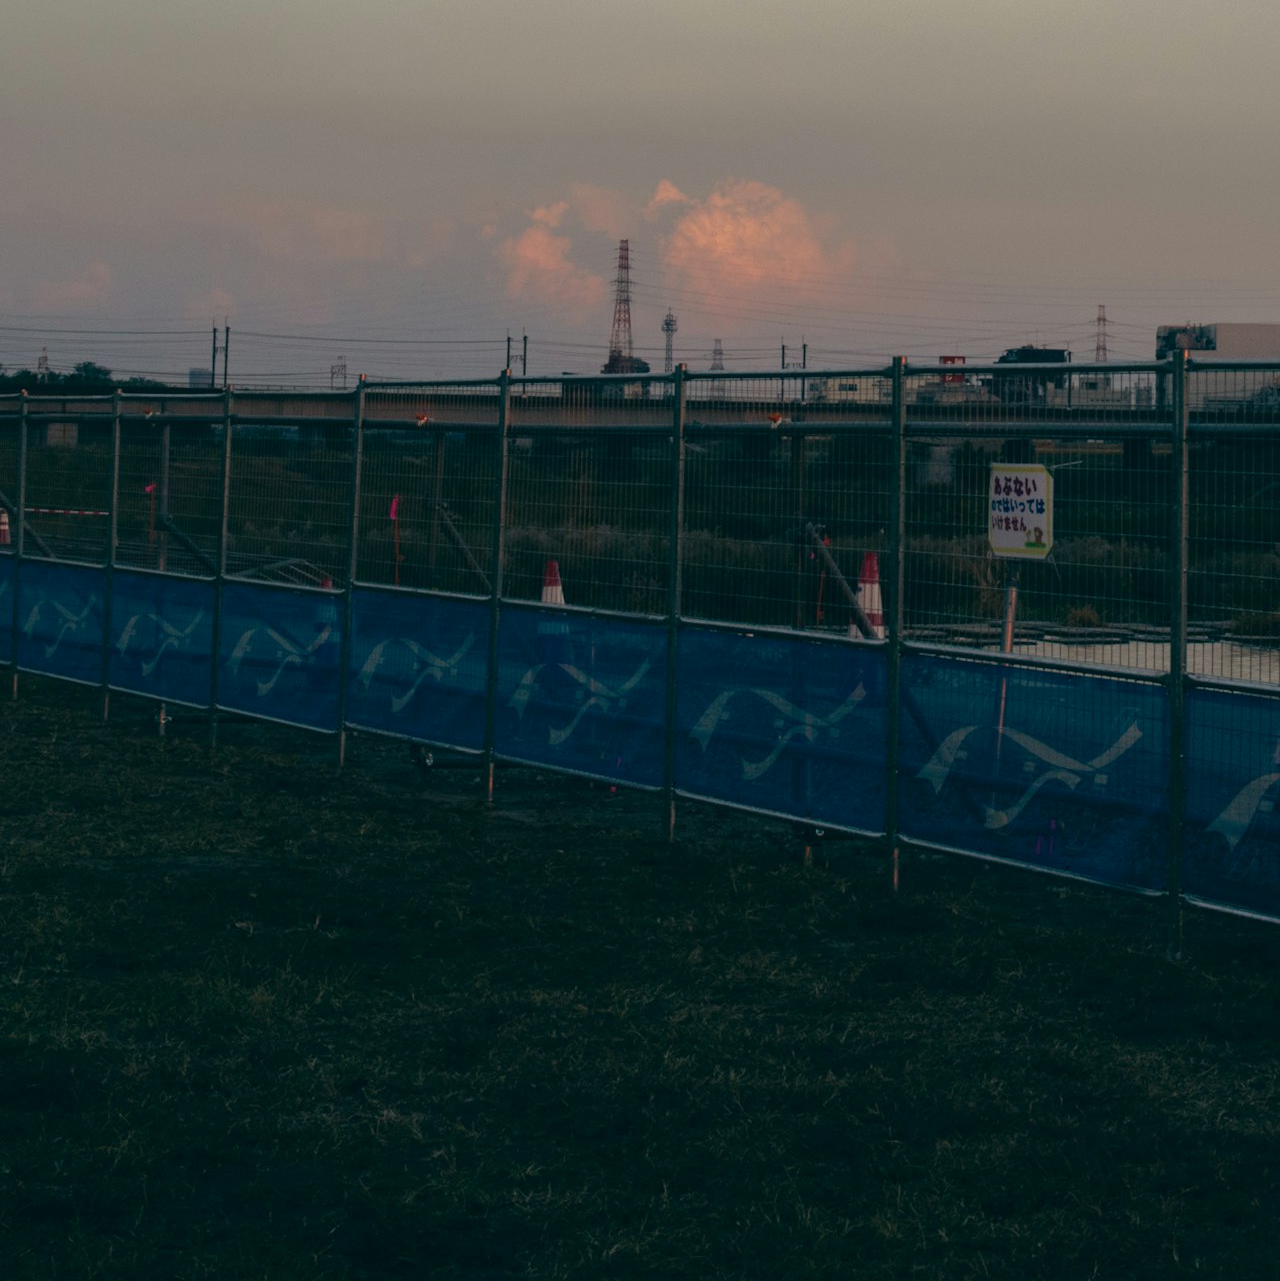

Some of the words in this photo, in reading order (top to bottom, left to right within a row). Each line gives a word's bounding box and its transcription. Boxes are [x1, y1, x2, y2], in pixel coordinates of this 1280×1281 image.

[994, 476, 1036, 496] あぶない
[992, 498, 1044, 513] のではいっては
[992, 516, 1026, 531] いけません
